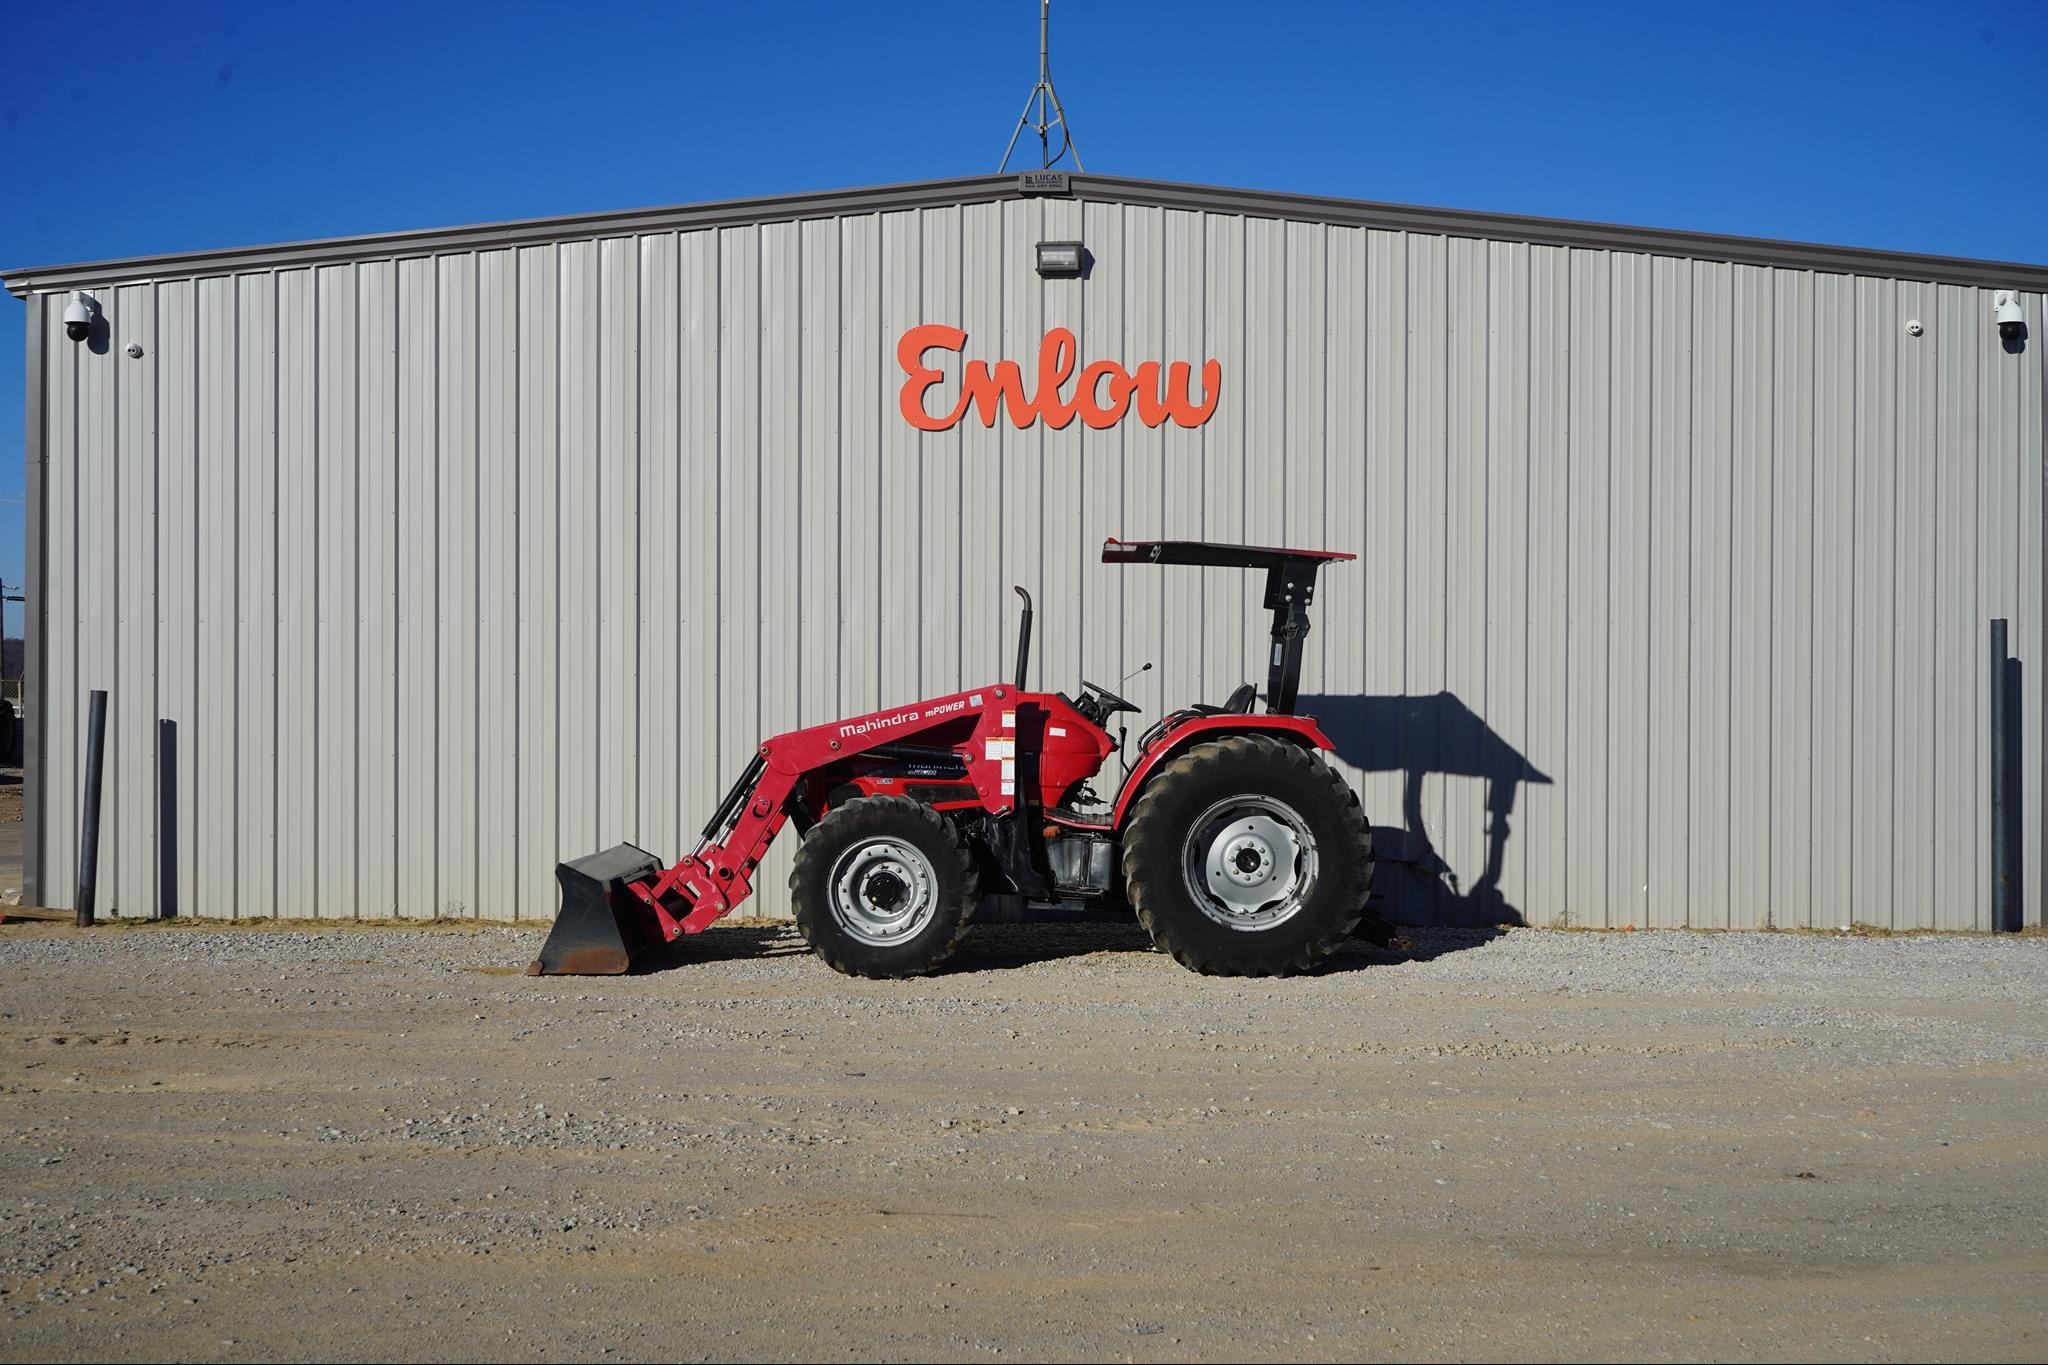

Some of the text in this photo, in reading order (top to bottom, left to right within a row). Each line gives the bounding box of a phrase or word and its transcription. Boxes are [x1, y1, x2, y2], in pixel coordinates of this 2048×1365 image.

[897, 324, 1221, 431] Enlow
[840, 700, 965, 738] Mahindra mPOWER
